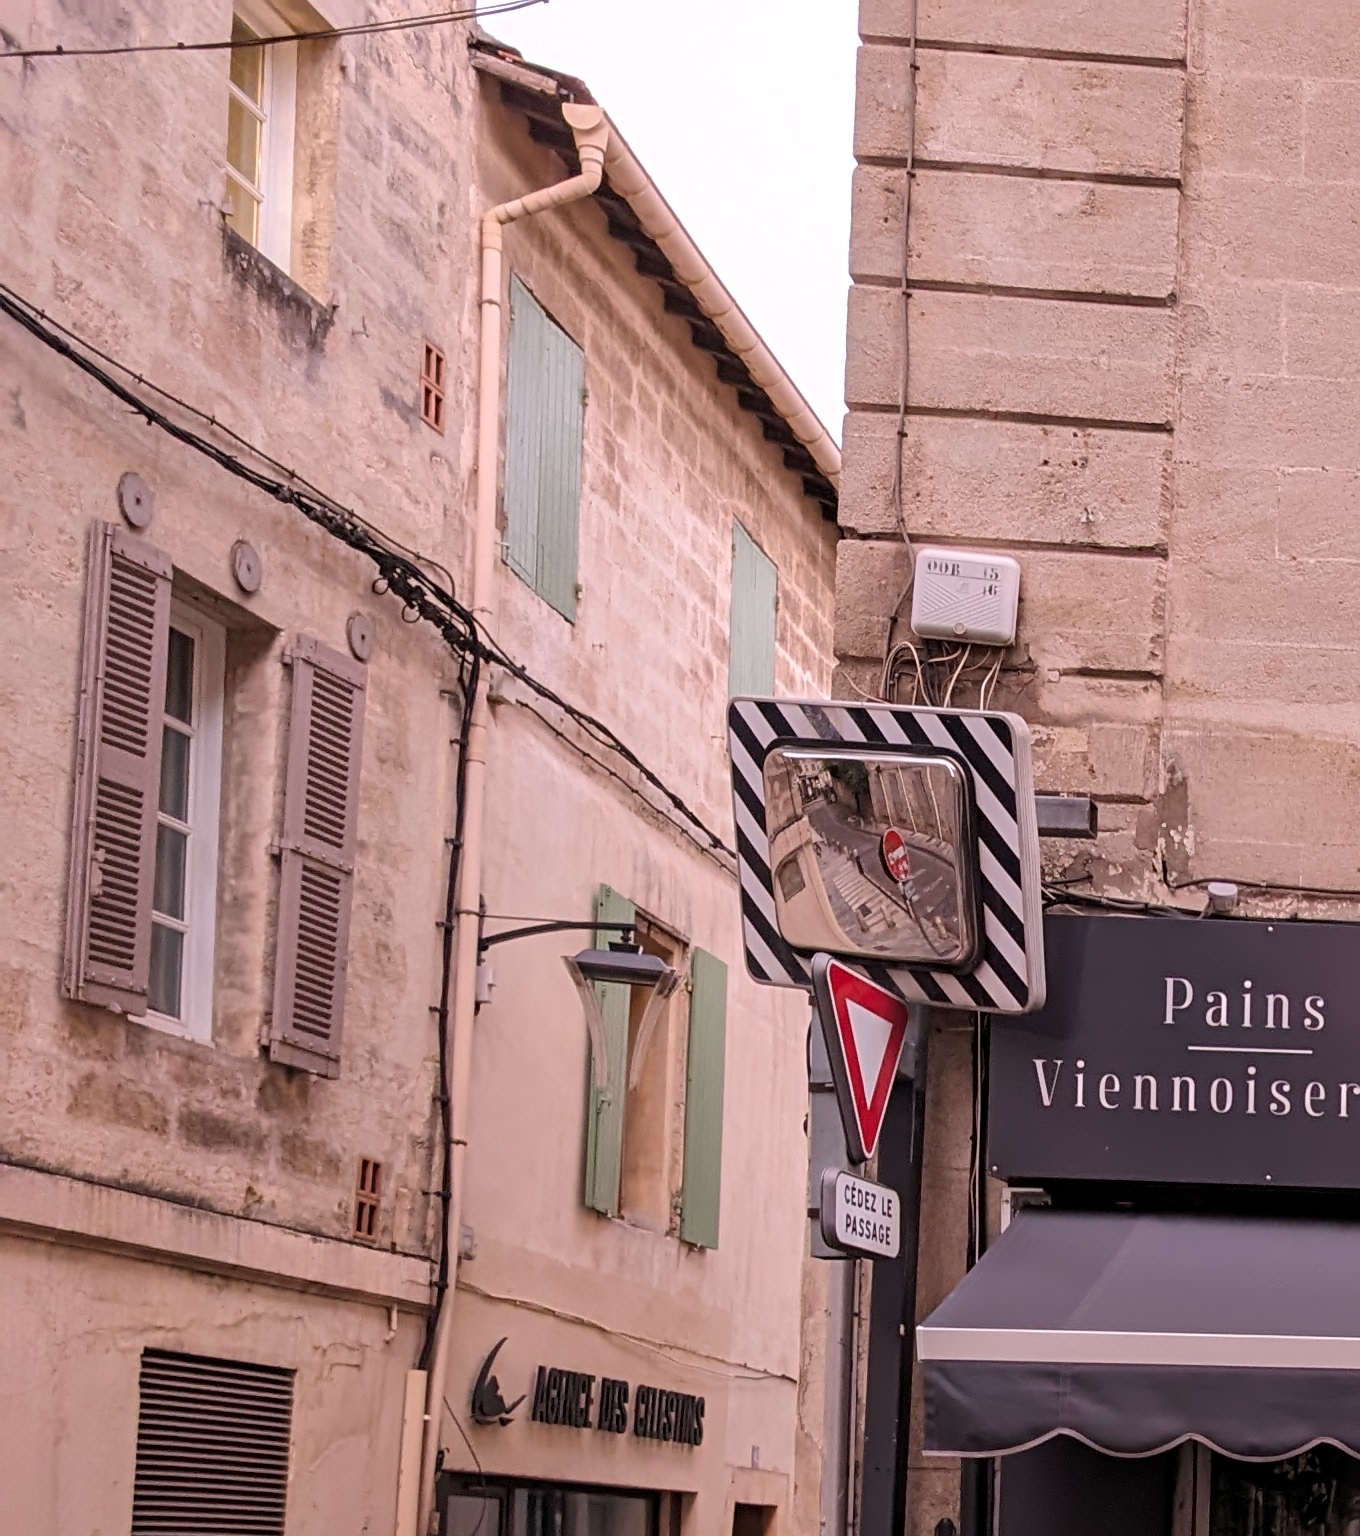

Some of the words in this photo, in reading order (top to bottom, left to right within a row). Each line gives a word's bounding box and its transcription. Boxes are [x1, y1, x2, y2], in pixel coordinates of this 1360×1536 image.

[1163, 976, 1326, 1031] Pains
[844, 1182, 877, 1213] CÉDEZ
[881, 1197, 893, 1218] LE
[845, 1213, 891, 1246] PASSAGE
[531, 1365, 597, 1429] AGENCE
[598, 1377, 630, 1434] DES
